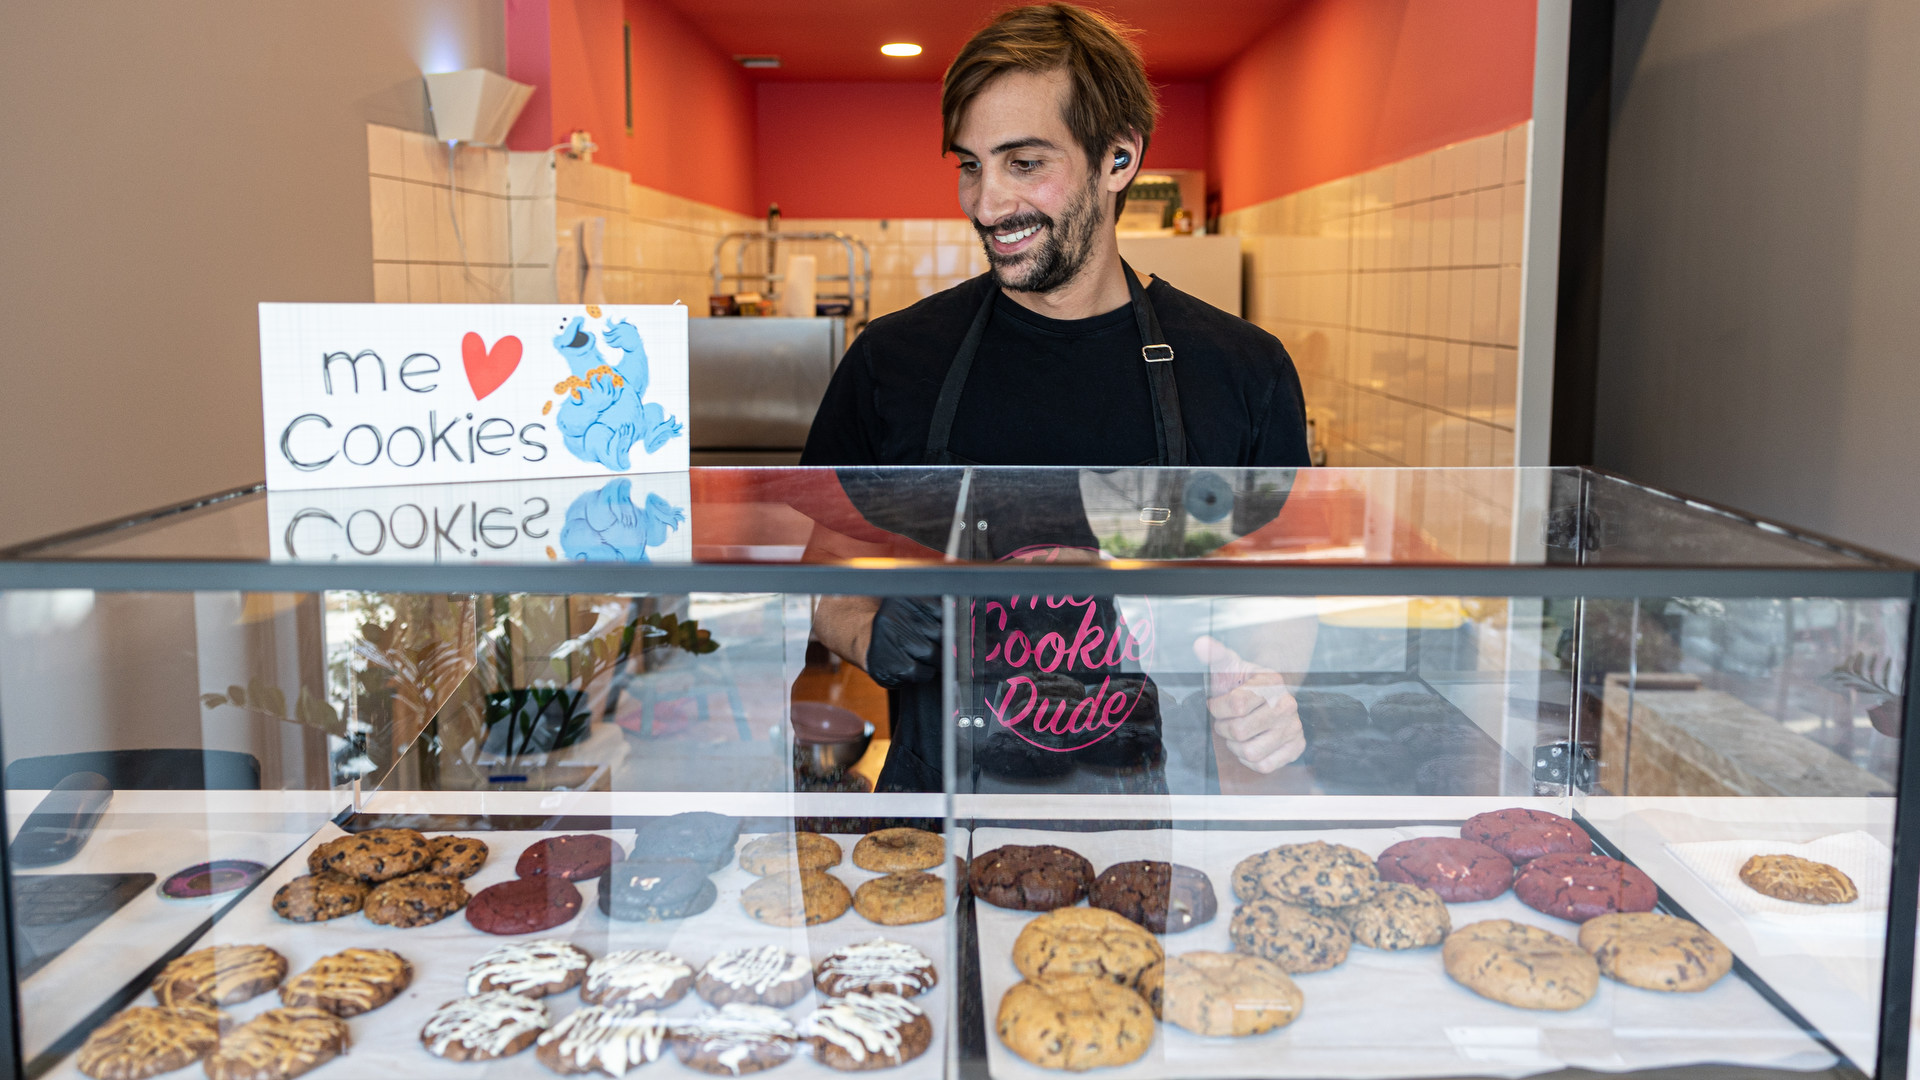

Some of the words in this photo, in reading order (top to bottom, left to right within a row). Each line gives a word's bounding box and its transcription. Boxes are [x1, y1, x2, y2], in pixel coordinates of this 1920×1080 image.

[323, 349, 441, 395] me
[281, 410, 548, 472] Cookies
[970, 600, 1152, 673] Cookie
[998, 675, 1128, 735] Dude
